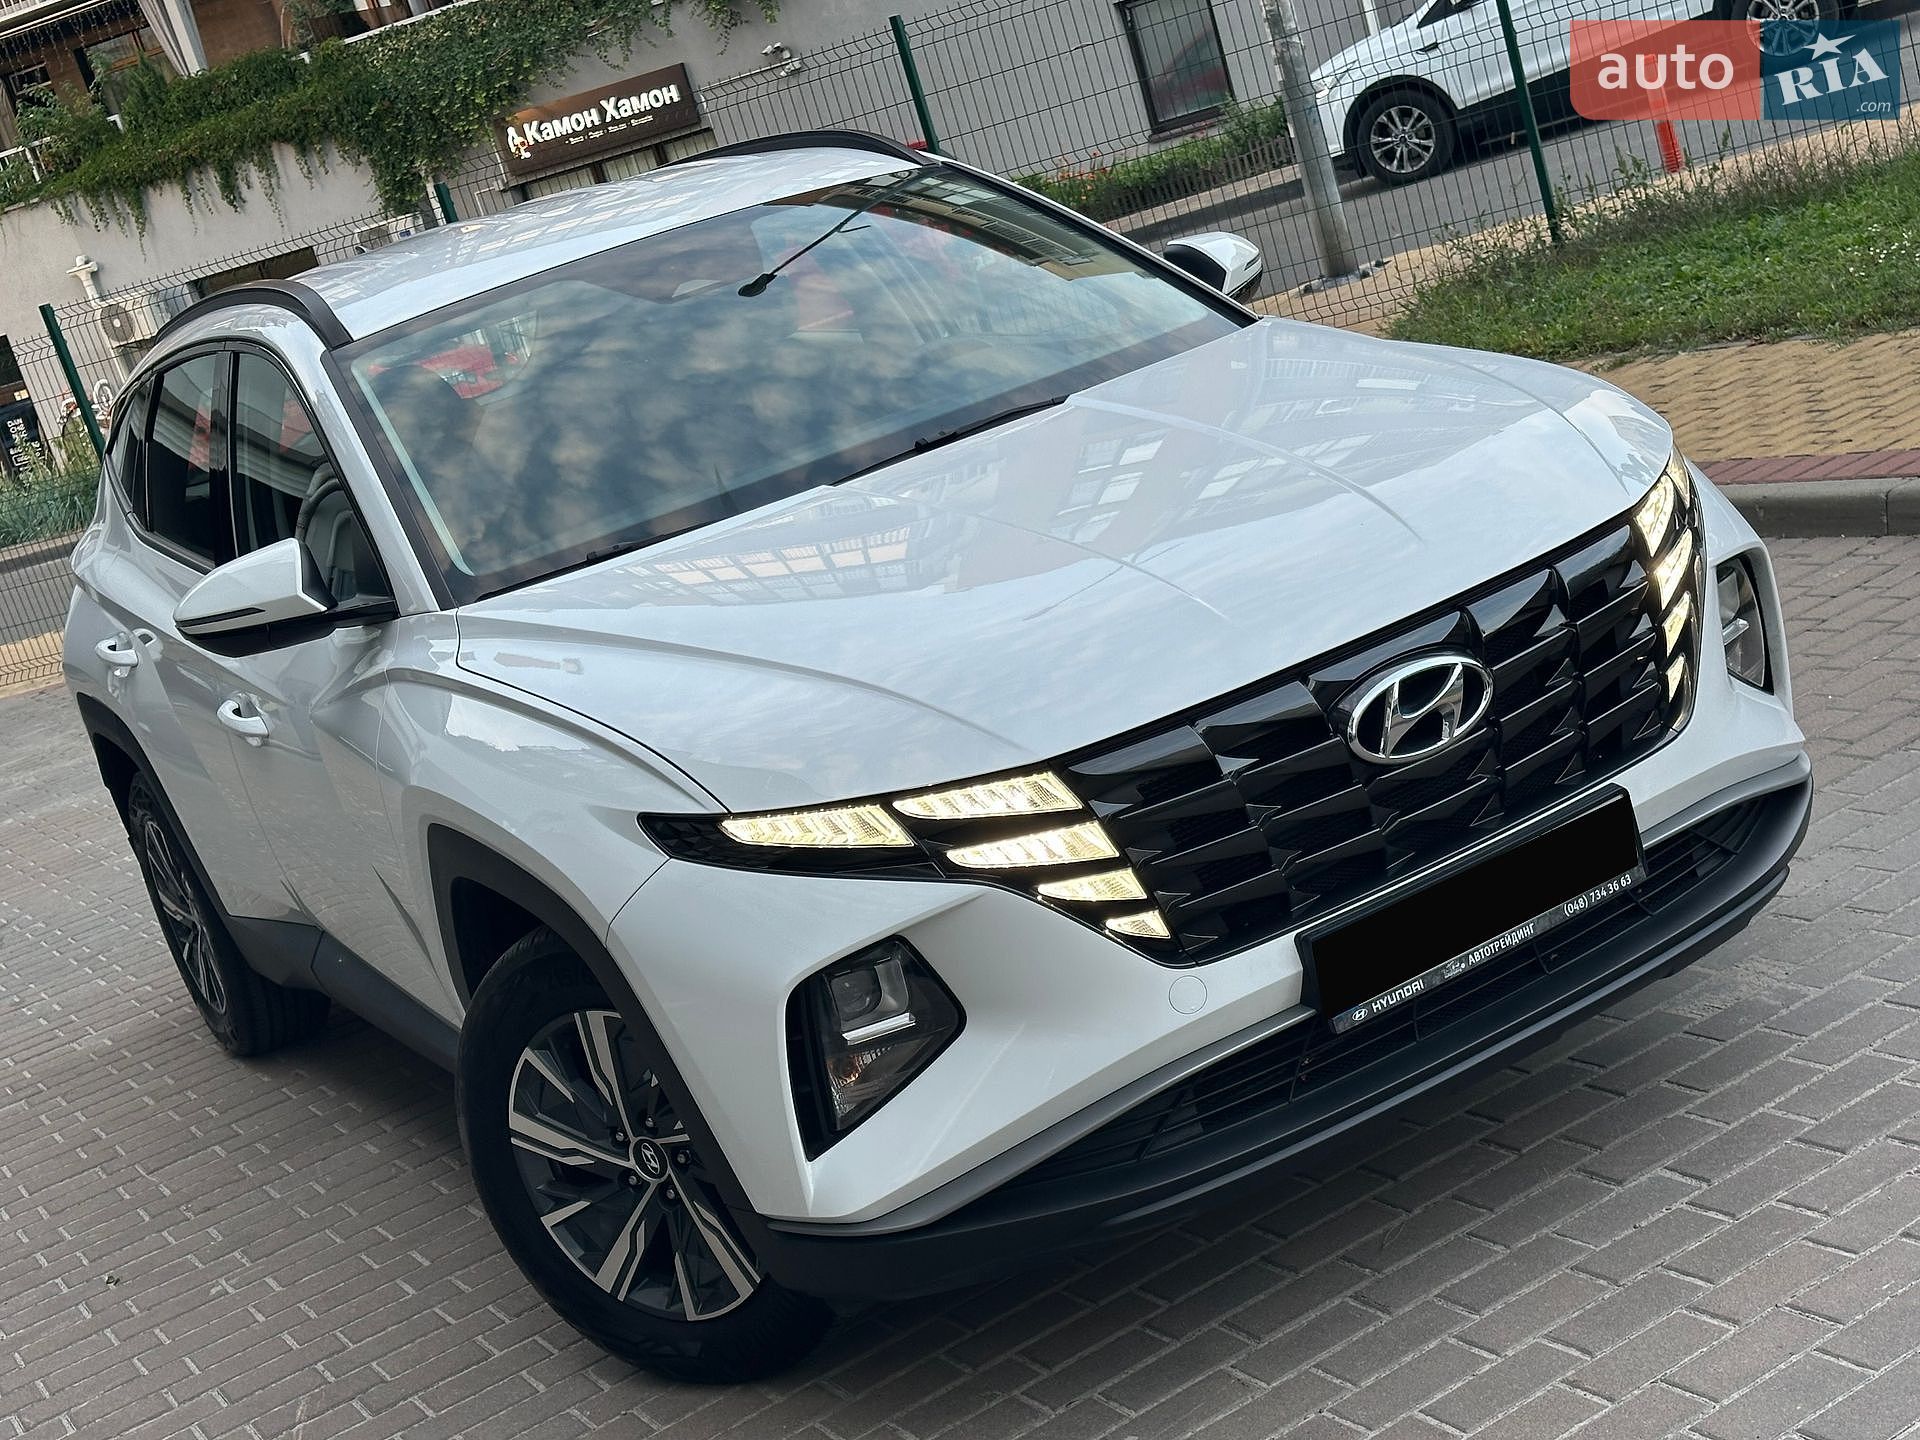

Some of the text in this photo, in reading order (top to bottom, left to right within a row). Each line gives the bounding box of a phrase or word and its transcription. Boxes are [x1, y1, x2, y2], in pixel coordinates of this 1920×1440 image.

[522, 107, 601, 146] Камон
[600, 84, 681, 123] Хамон
[1563, 873, 1633, 917] (048) 734 36 63
[1468, 922, 1535, 966] АВТОТРЕЙДИНГ
[1372, 979, 1425, 1013] HYUNDAI
